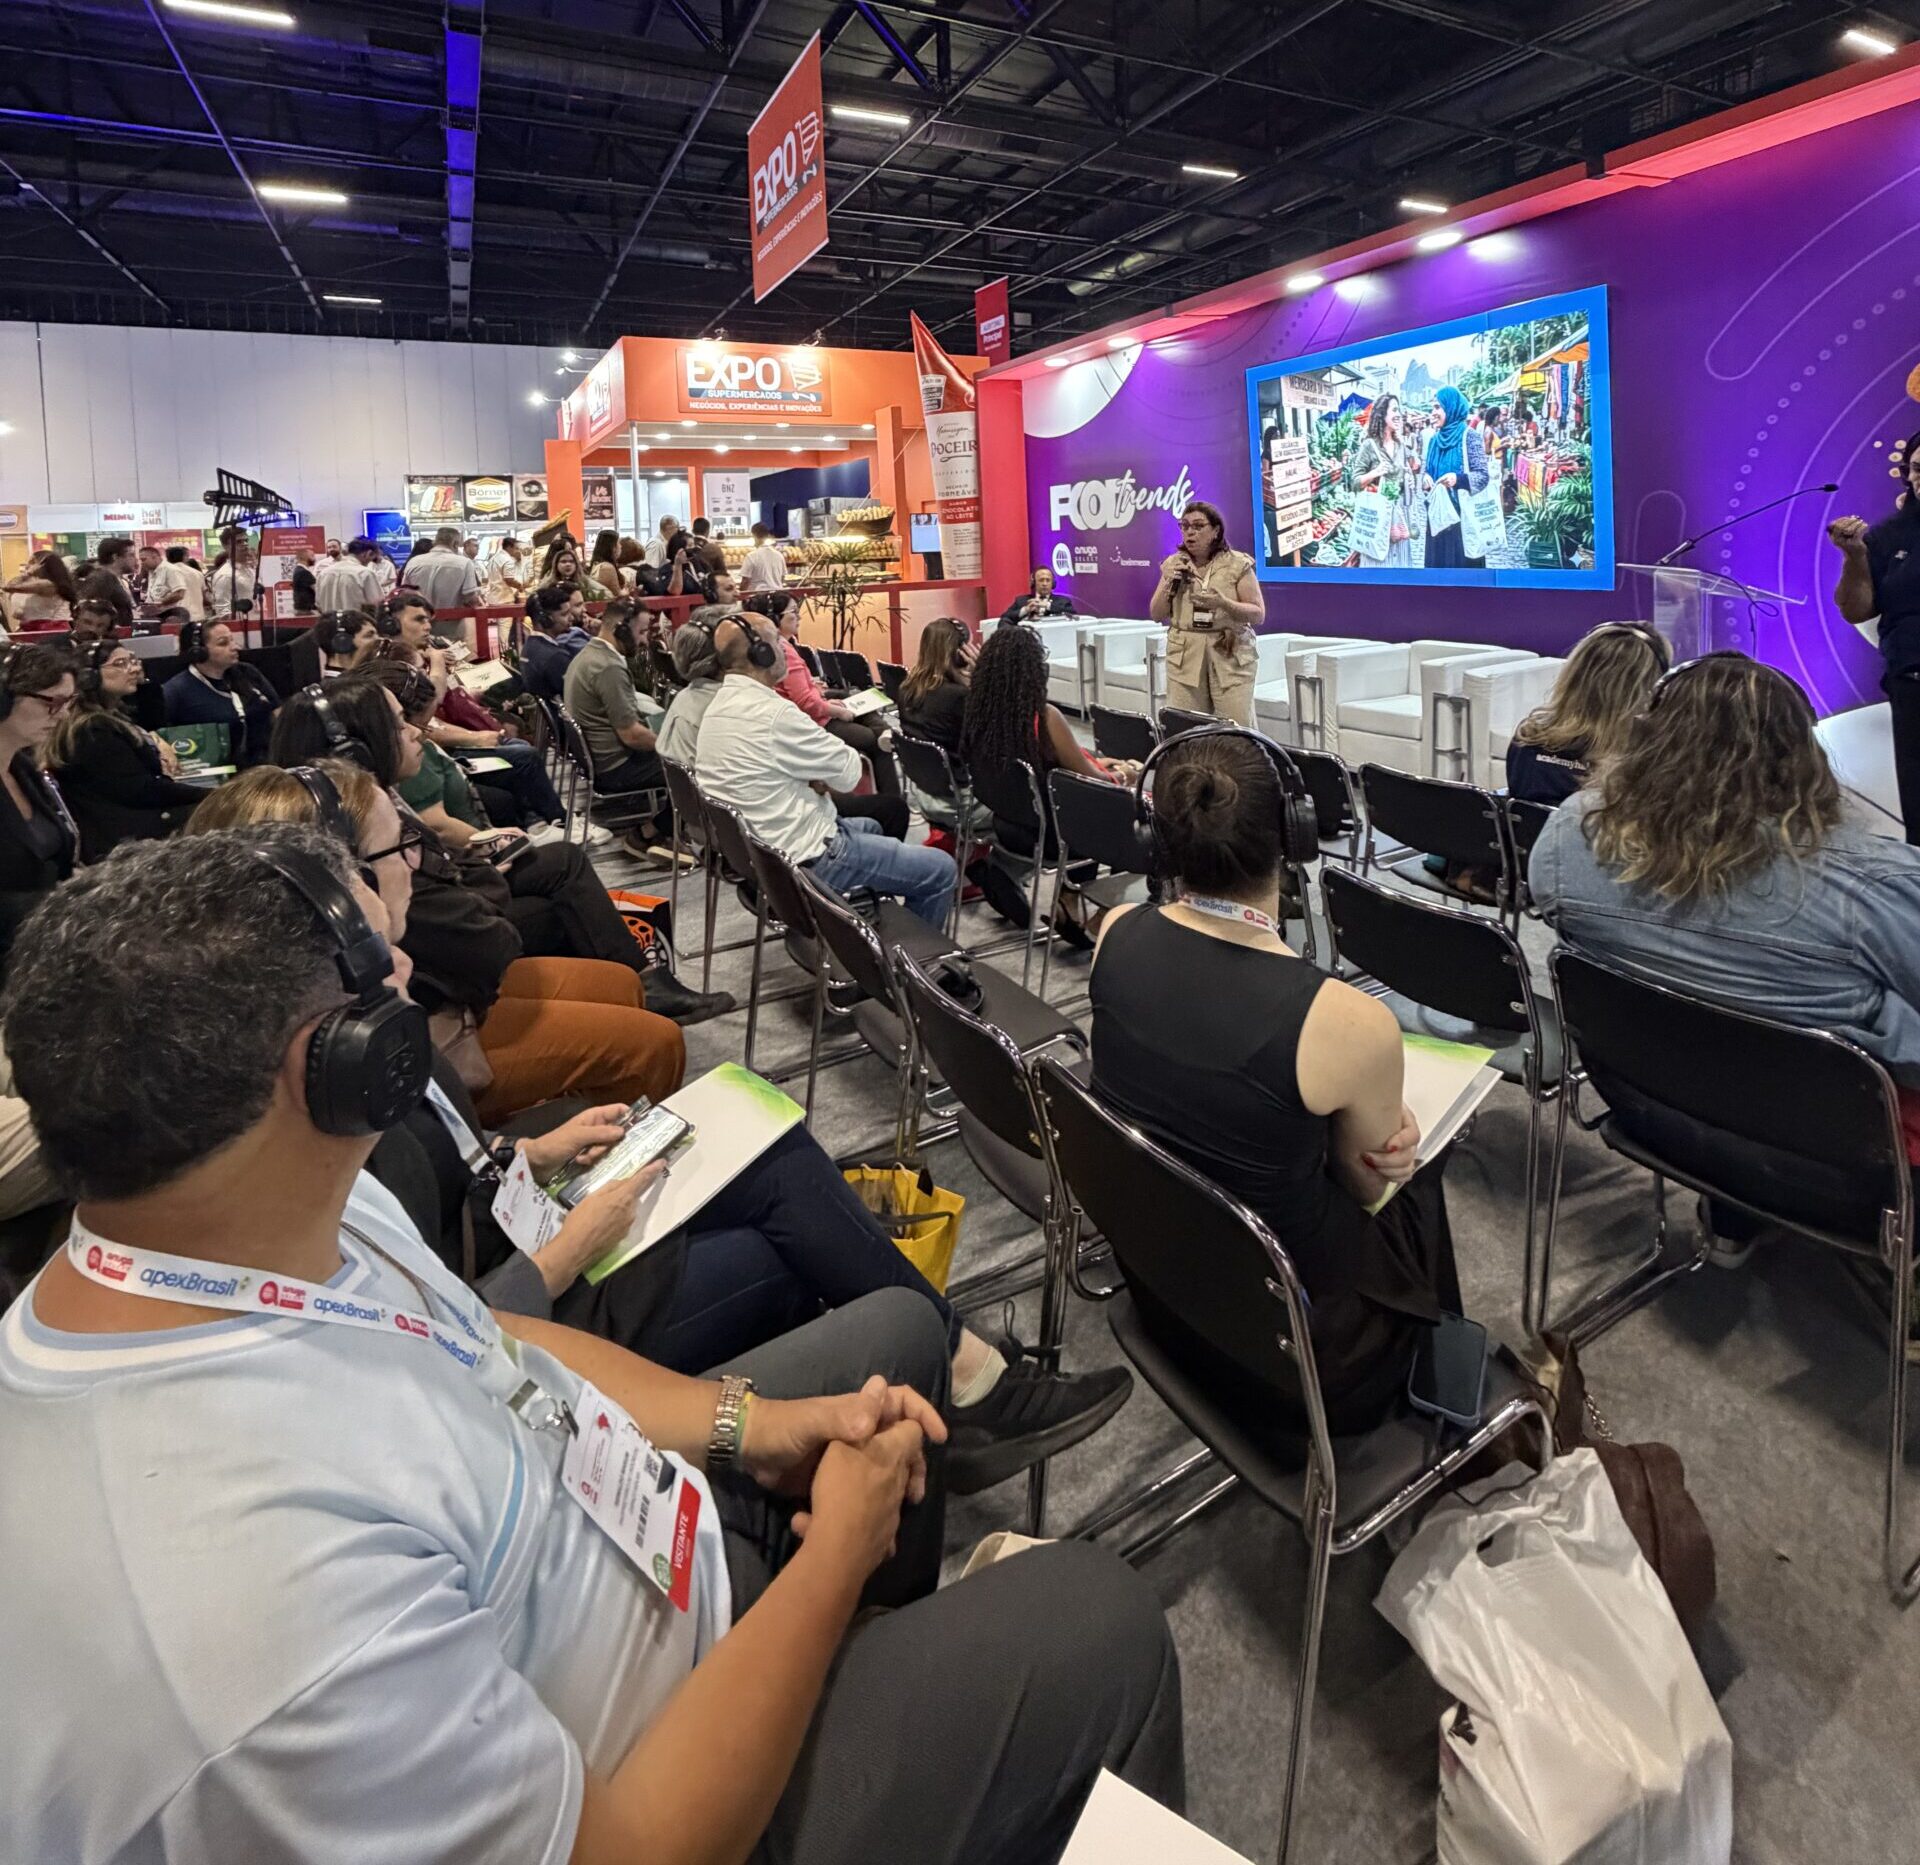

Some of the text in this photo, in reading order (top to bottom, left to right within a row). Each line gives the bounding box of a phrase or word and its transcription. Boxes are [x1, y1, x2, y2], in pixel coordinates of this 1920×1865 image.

[754, 130, 797, 224] EXPO
[686, 352, 781, 391] EXPO
[707, 389, 782, 400] SUPERMERCADOS
[728, 401, 778, 411] EXPERIÊNCIAS
[140, 1268, 238, 1297] apexBrasil
[314, 1298, 380, 1323] apexBrasil
[673, 1513, 690, 1570] VISITANTE
